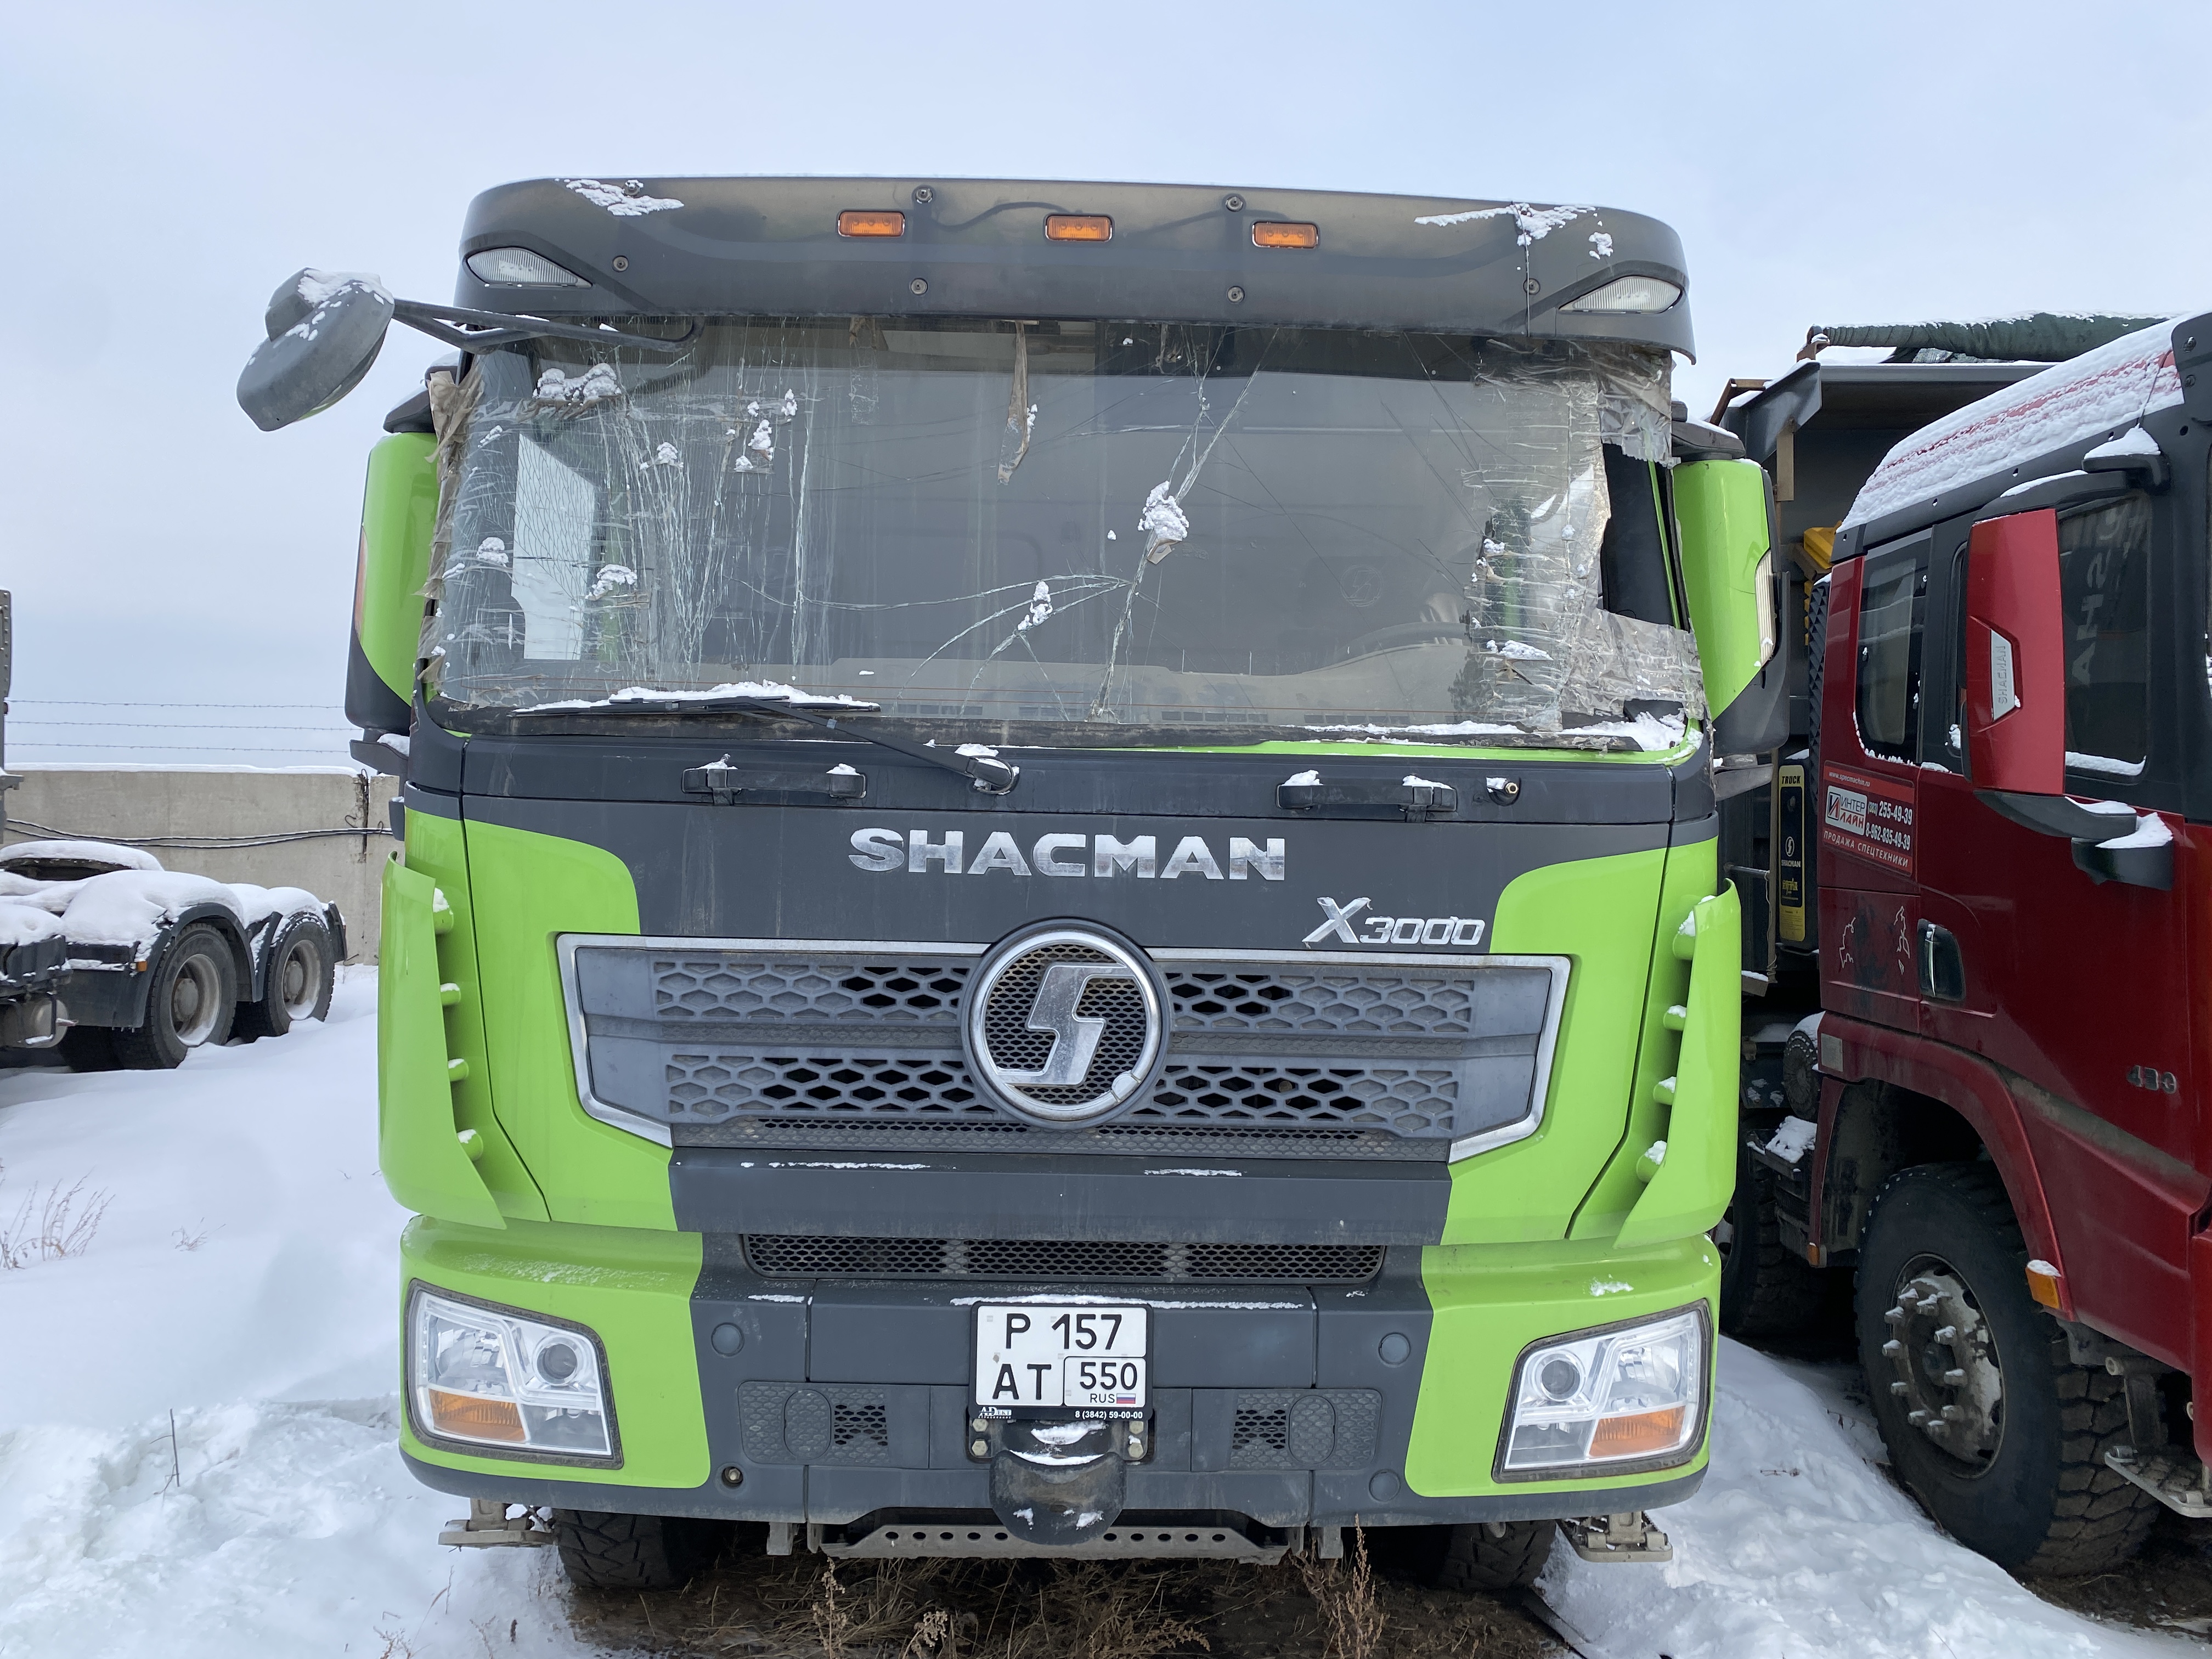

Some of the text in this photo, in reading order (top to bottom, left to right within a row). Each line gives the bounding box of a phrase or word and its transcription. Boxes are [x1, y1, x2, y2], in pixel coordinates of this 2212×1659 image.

[1995, 645, 2008, 705] SHACMAN
[1781, 775, 1801, 785] TRUCK
[1841, 795, 1865, 812] ИНТЕР
[1878, 800, 1913, 826] 255-49-39
[1839, 812, 1864, 829] ЛАЙН
[1824, 830, 1909, 868] ПРОДАЖА СПЕЦТЕХНИКИ
[1865, 822, 1911, 851] 8-962-835-49-39
[848, 827, 1285, 881] SHACMAN
[1301, 896, 1485, 946] X3000
[1051, 1313, 1122, 1350] 157
[1079, 1362, 1138, 1390] 550
[1090, 1393, 1115, 1403] RUS
[1082, 1410, 1107, 1420] (3842)
